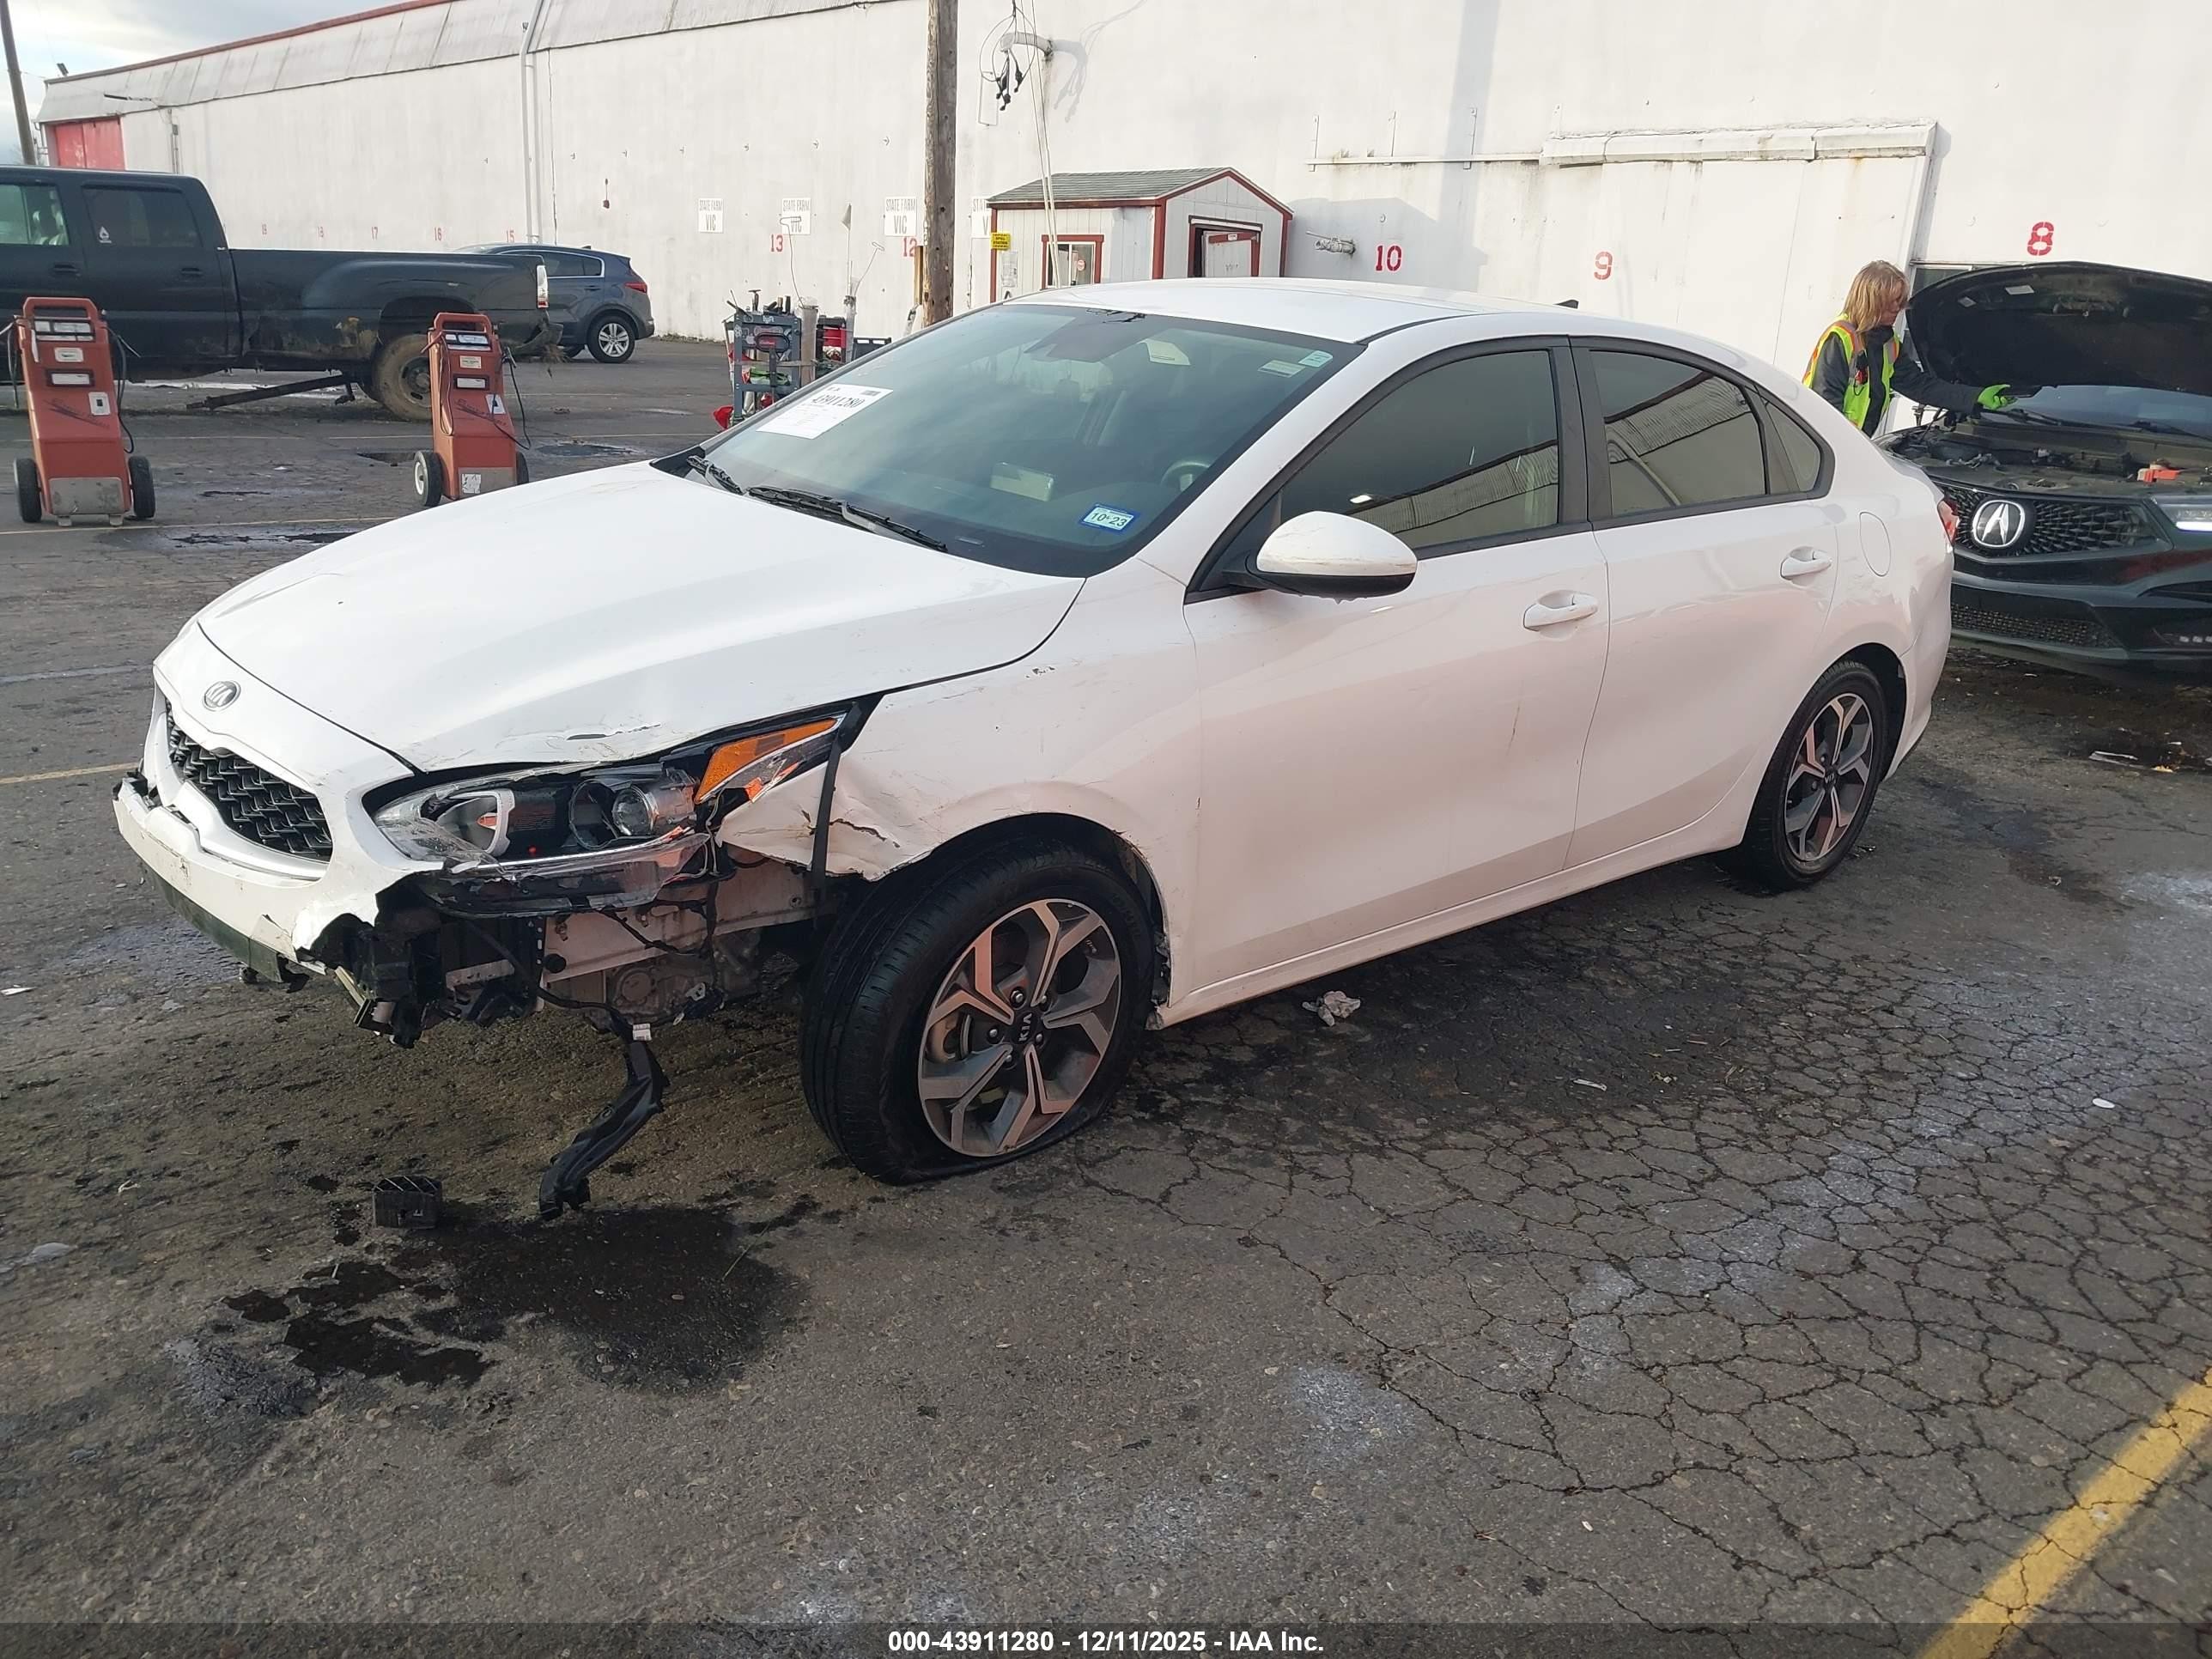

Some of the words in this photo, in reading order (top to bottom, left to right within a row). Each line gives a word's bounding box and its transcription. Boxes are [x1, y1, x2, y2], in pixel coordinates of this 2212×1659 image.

[699, 199, 710, 211] STATE
[782, 199, 795, 211] STATE
[796, 199, 810, 211] FARM
[885, 198, 899, 212] STATE
[901, 198, 916, 213] FARM
[706, 214, 716, 231] VIC
[893, 215, 908, 234] VIC
[371, 226, 379, 241] 17
[434, 226, 442, 241] 16
[506, 229, 515, 243] 15
[2027, 222, 2055, 257] 8
[770, 234, 784, 252] 13
[902, 237, 918, 257] 12
[1376, 245, 1402, 272] 10
[1593, 251, 1613, 281] 9
[1018, 1012, 1032, 1042] KIA
